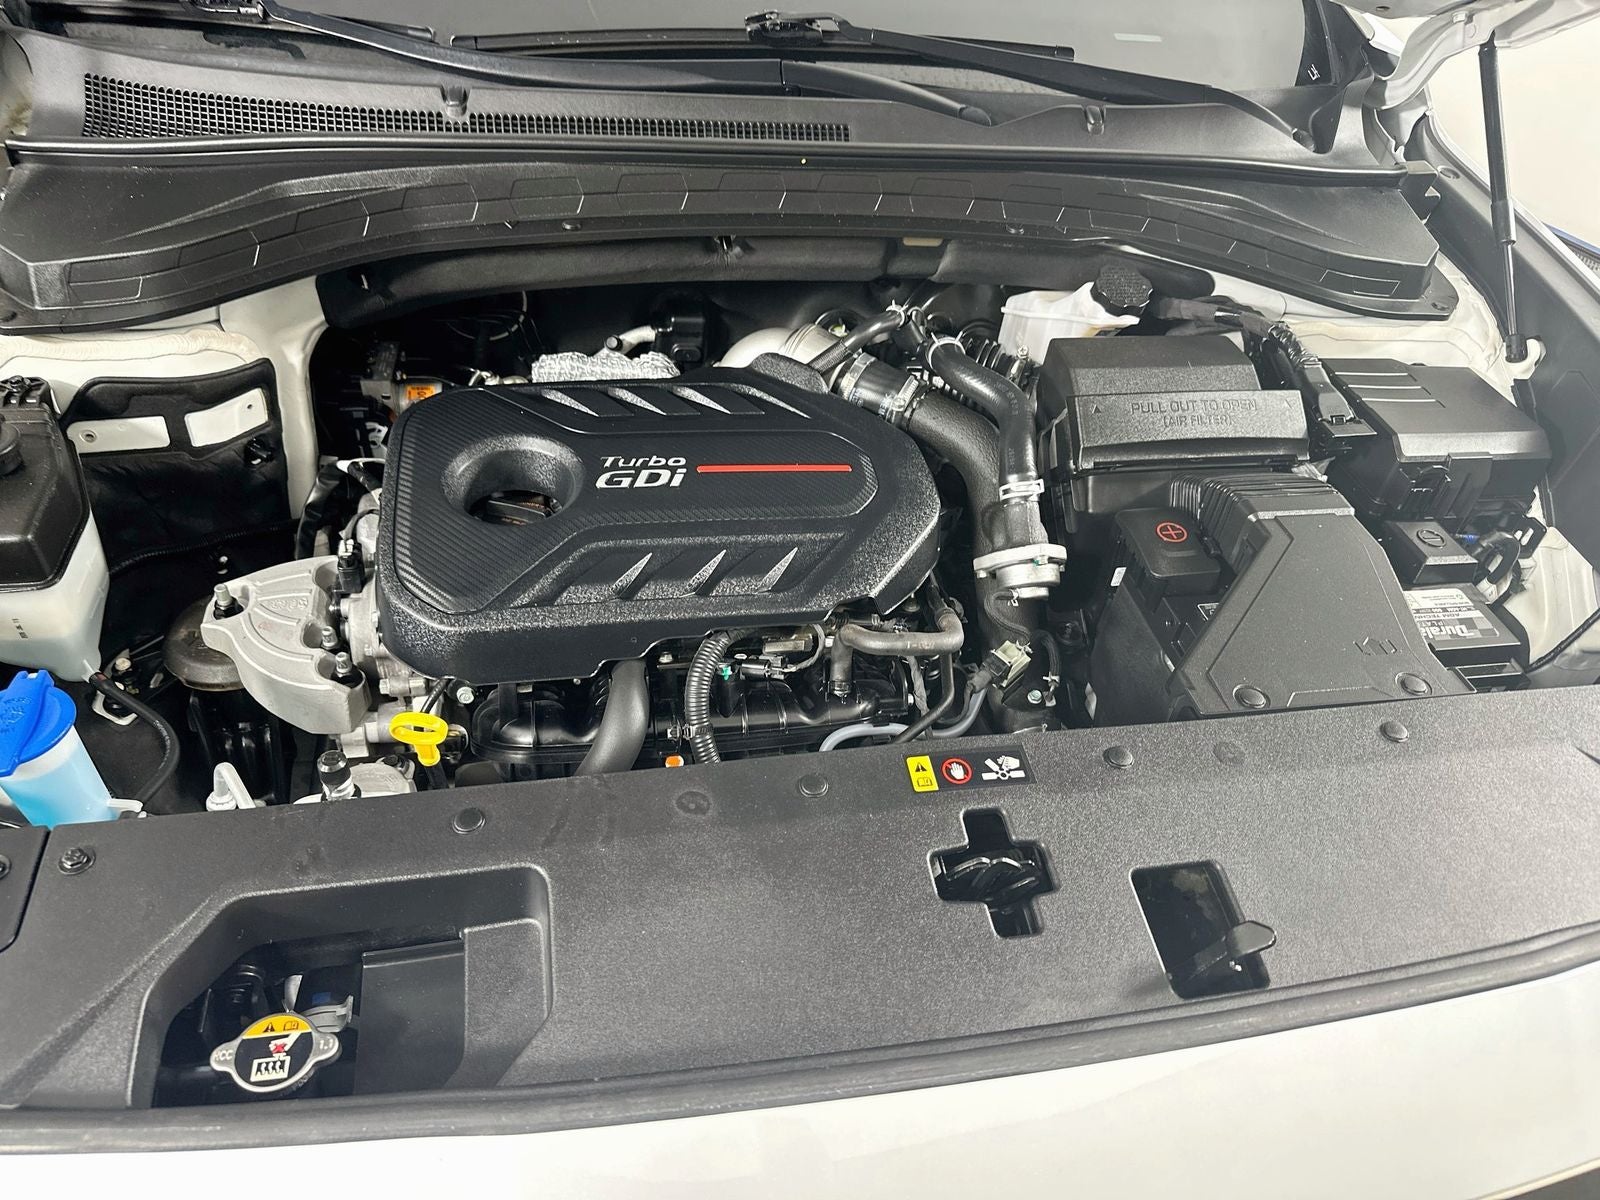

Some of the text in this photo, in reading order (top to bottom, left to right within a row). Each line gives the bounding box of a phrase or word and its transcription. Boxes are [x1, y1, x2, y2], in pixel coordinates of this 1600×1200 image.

[1131, 399, 1257, 414] PULL OUT TO OPEN
[1163, 415, 1187, 427] (AIR
[600, 455, 687, 468] Turbo
[595, 468, 687, 489] GDi
